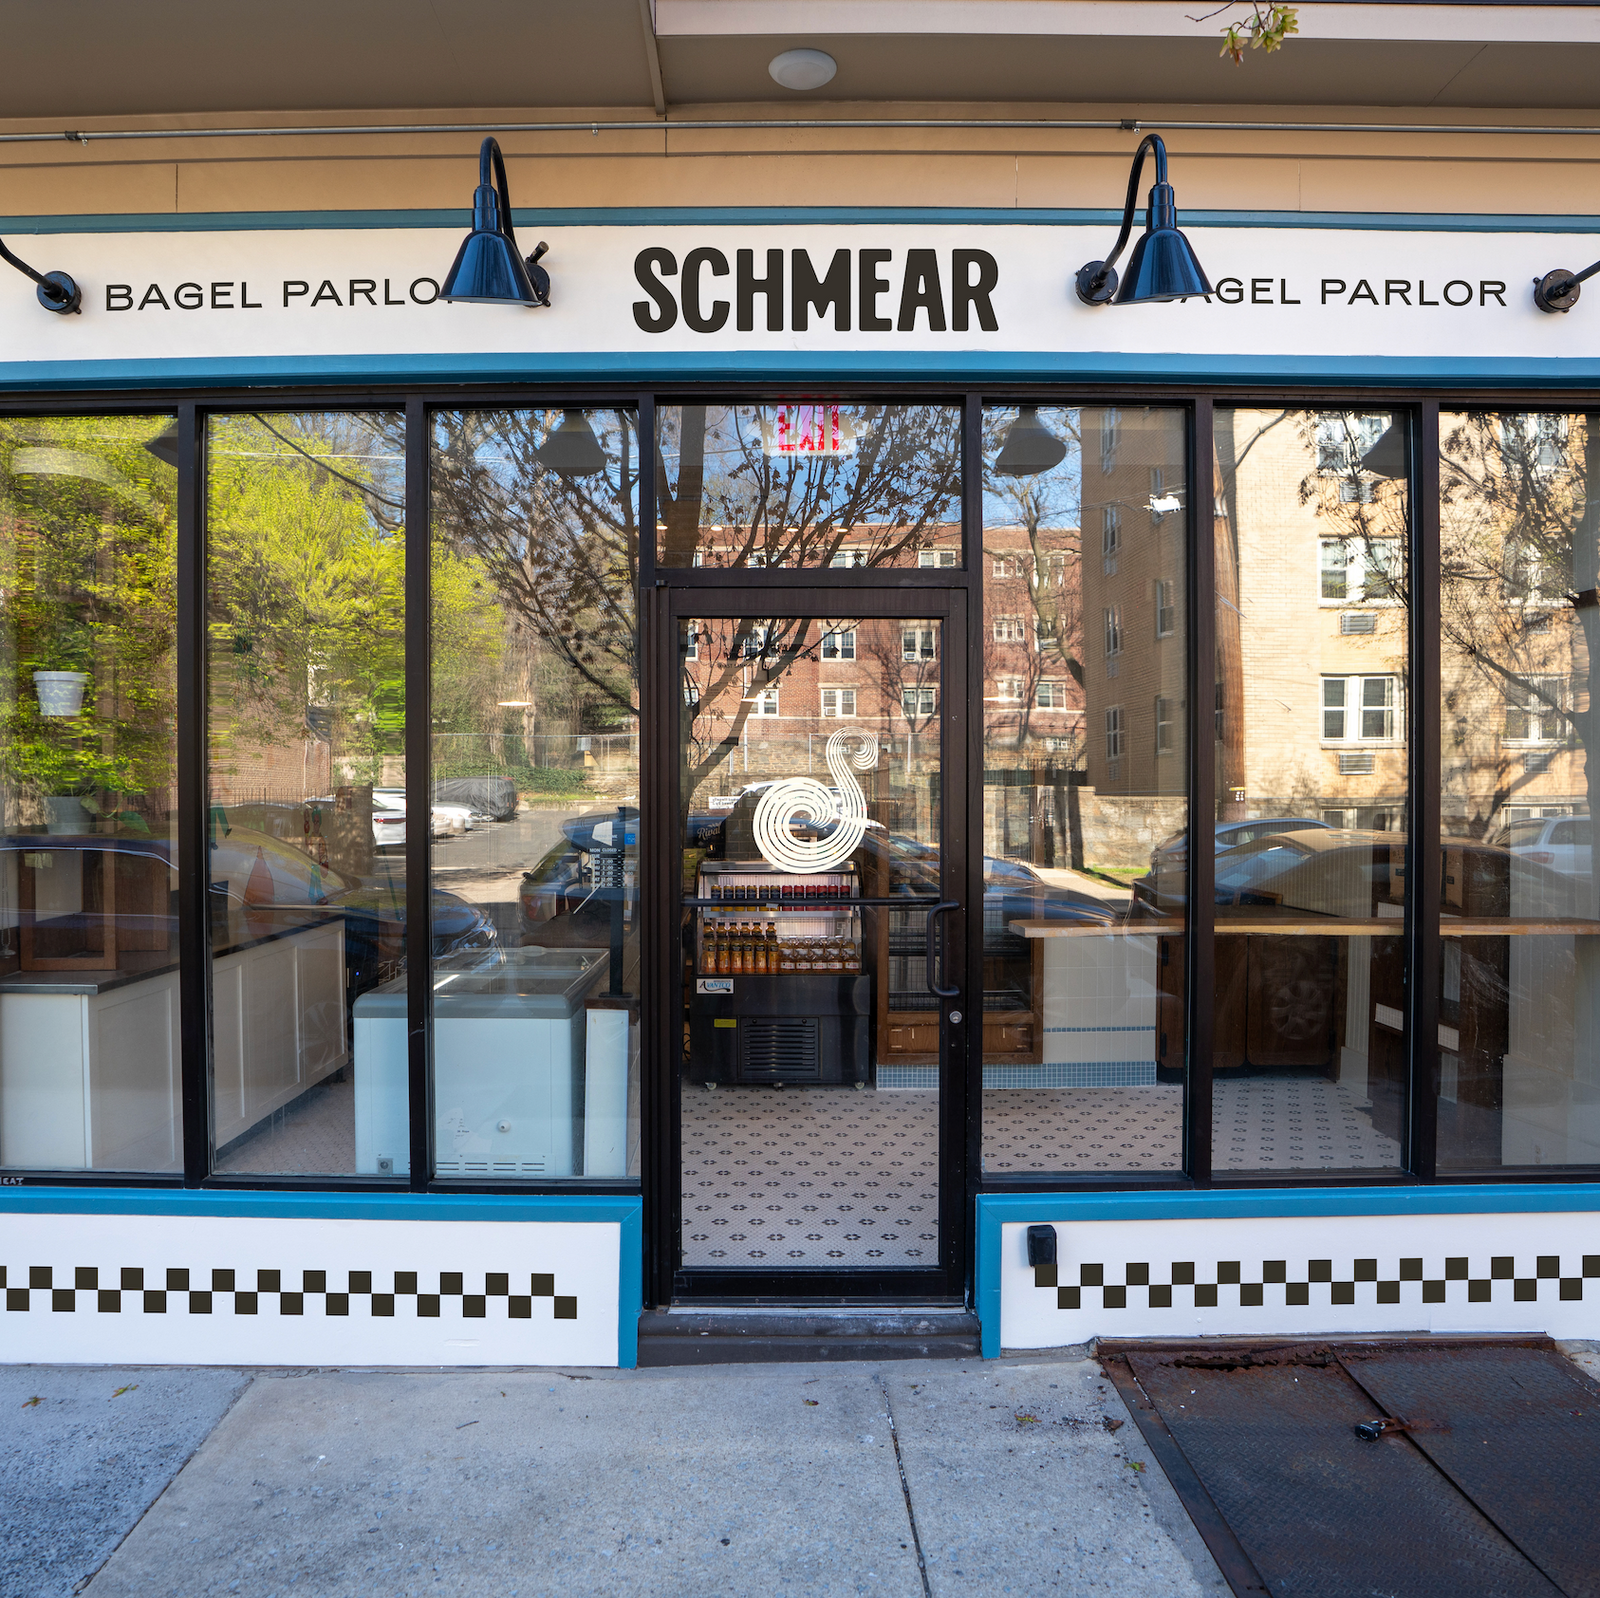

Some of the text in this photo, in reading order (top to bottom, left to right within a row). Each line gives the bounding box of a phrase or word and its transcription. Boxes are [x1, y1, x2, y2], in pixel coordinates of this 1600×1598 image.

[106, 277, 452, 311] BAGEL PARLO
[632, 246, 999, 334] SCHMEAR
[1161, 277, 1507, 307] GEL PARLOR
[778, 401, 842, 451] EXIT
